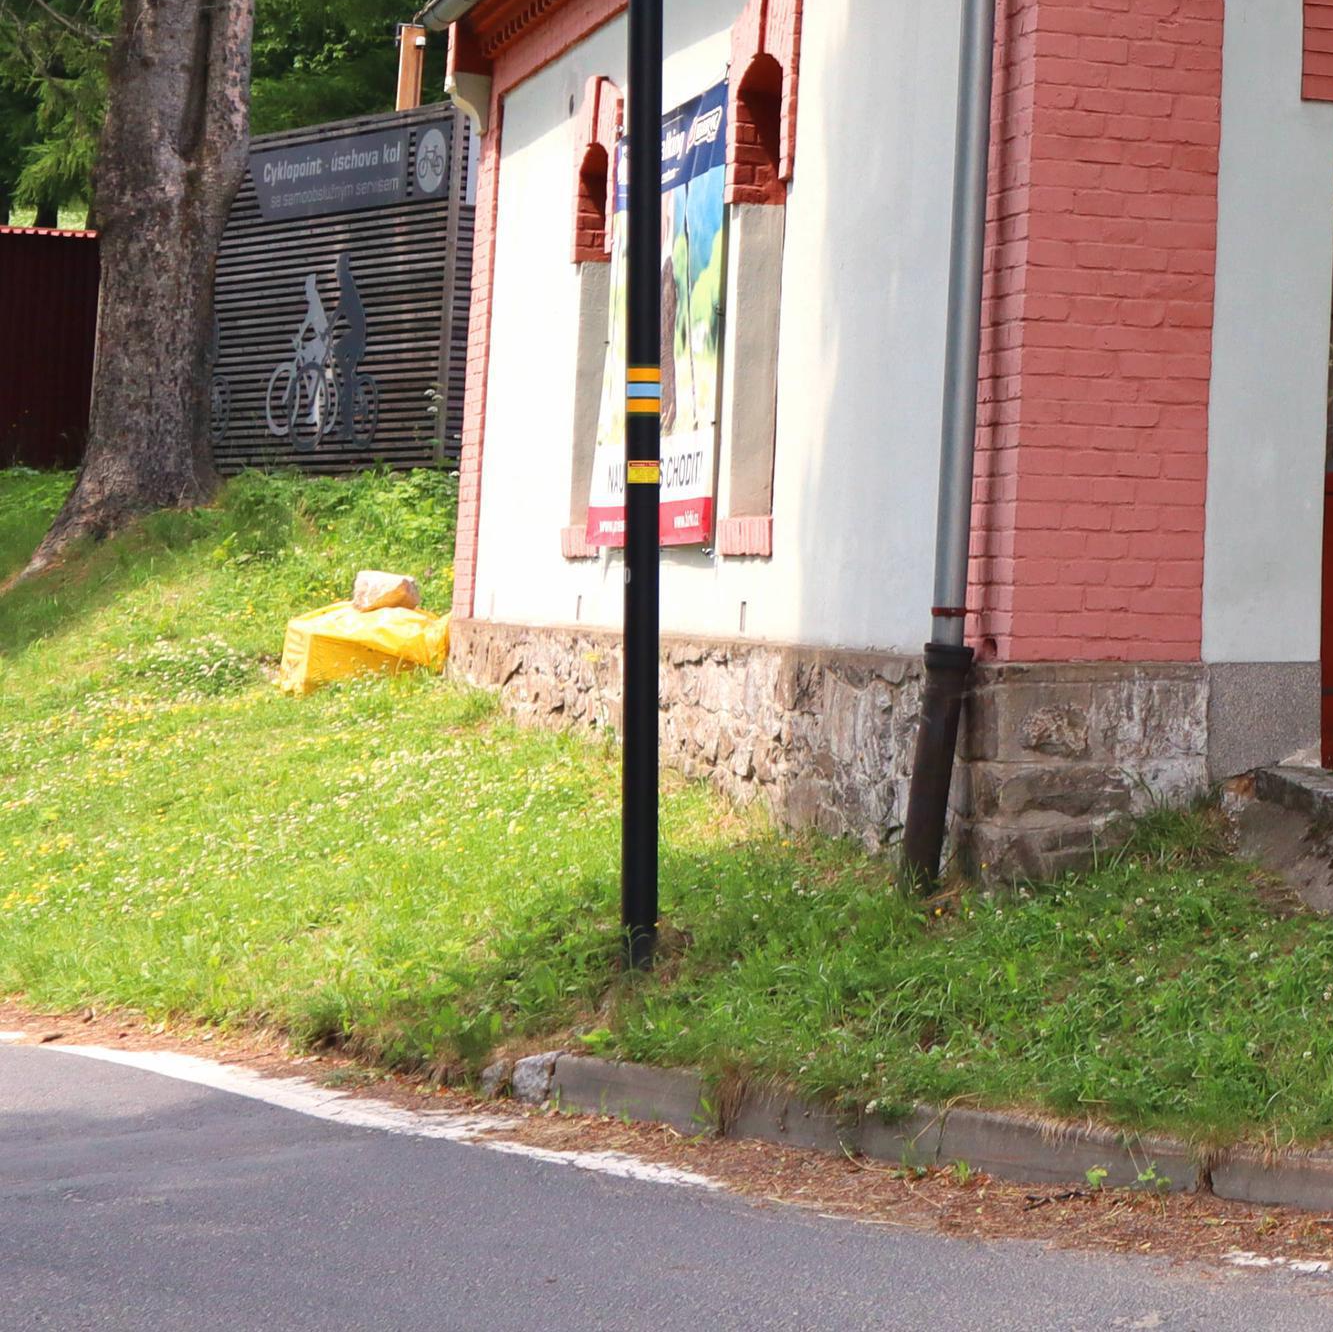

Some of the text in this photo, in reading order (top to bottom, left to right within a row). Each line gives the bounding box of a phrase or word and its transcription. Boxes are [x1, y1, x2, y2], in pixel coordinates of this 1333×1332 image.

[263, 156, 323, 187] Cyklopoint
[330, 149, 380, 172] úschova
[382, 141, 401, 164] kol
[667, 450, 704, 489] CHODIT!
